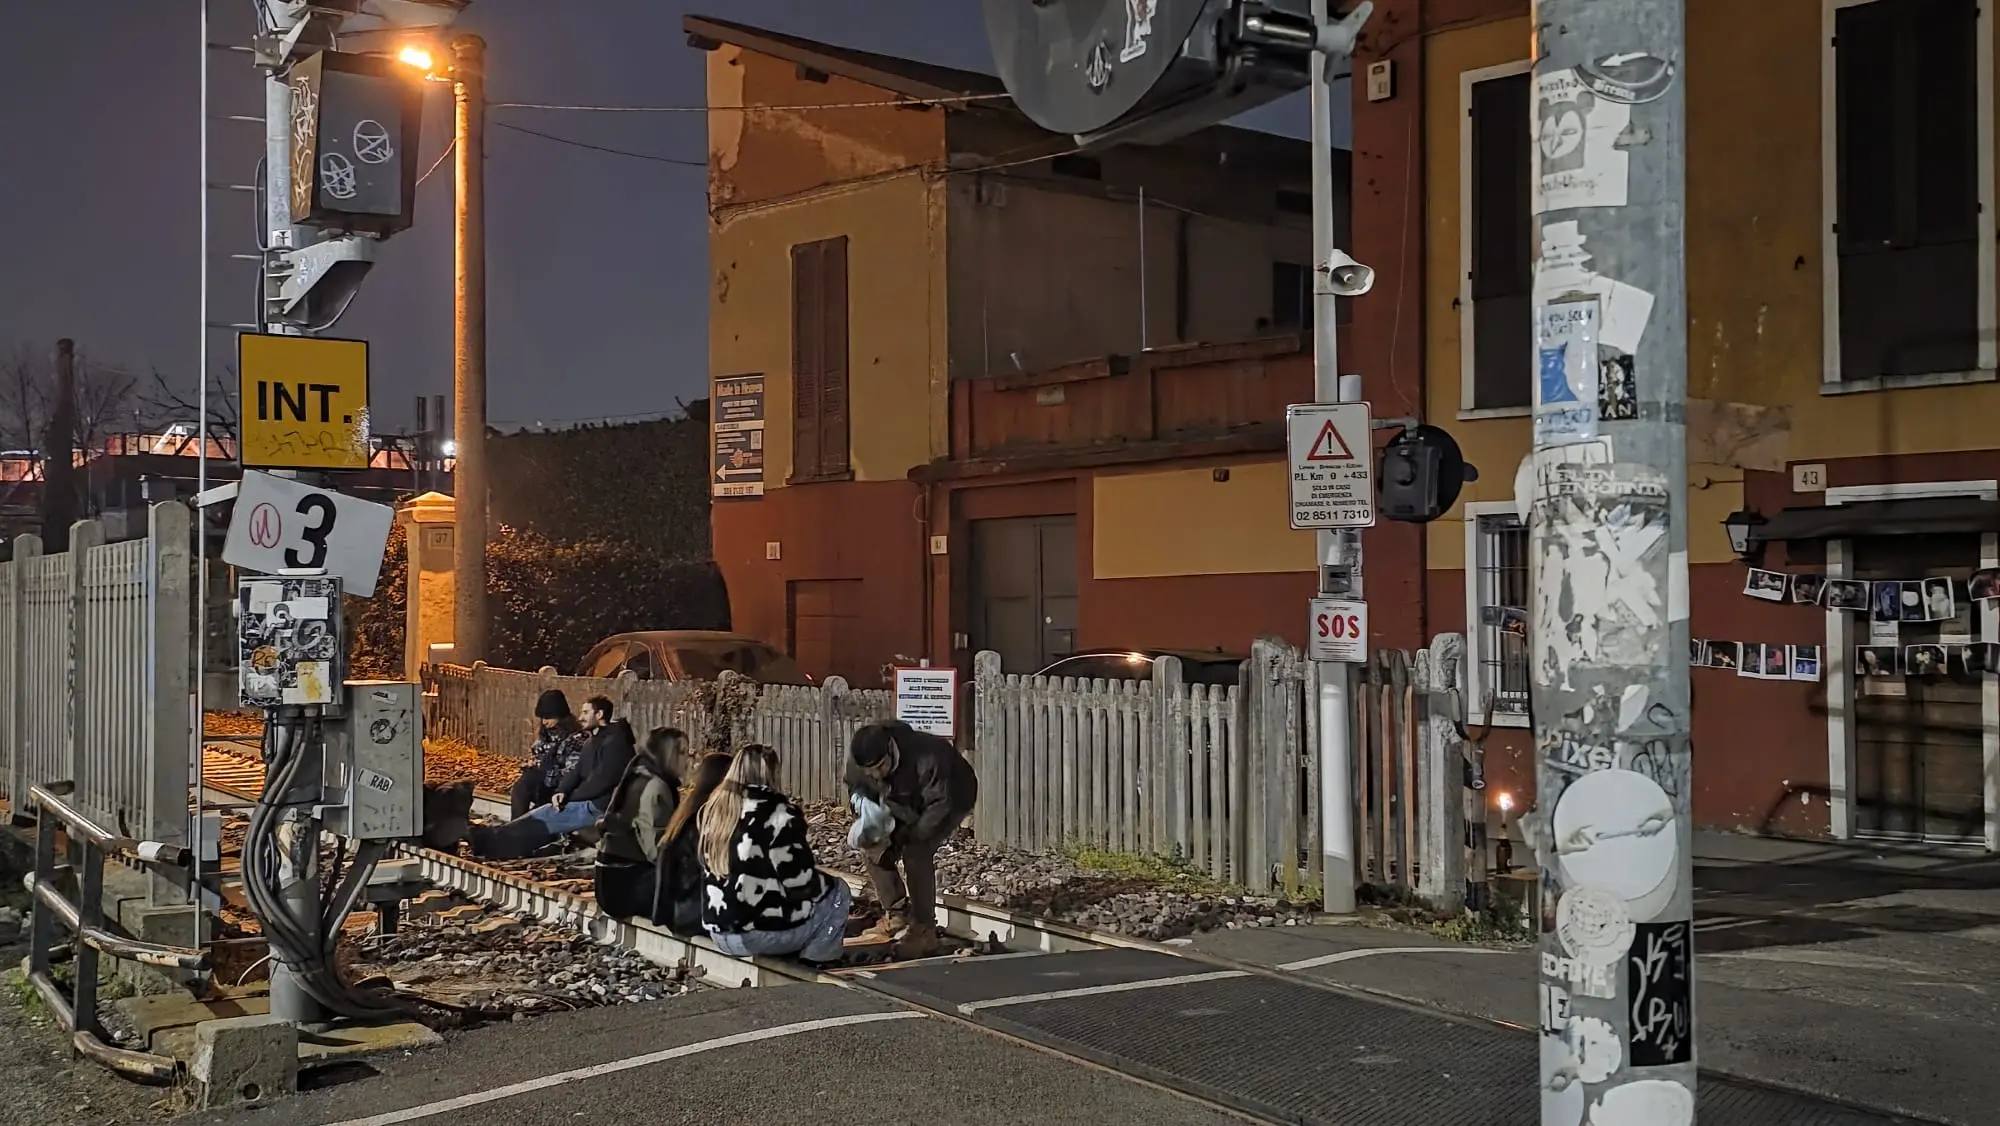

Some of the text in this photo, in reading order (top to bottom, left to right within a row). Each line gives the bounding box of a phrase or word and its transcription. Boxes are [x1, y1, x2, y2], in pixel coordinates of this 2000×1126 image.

[258, 381, 352, 423] INT.
[1310, 472, 1323, 480] Km
[1801, 472, 1818, 485] 43
[1296, 509, 1370, 520] 02 8511 7310
[284, 493, 337, 568] 3
[1317, 614, 1360, 639] SOS
[369, 775, 391, 792] RAB
